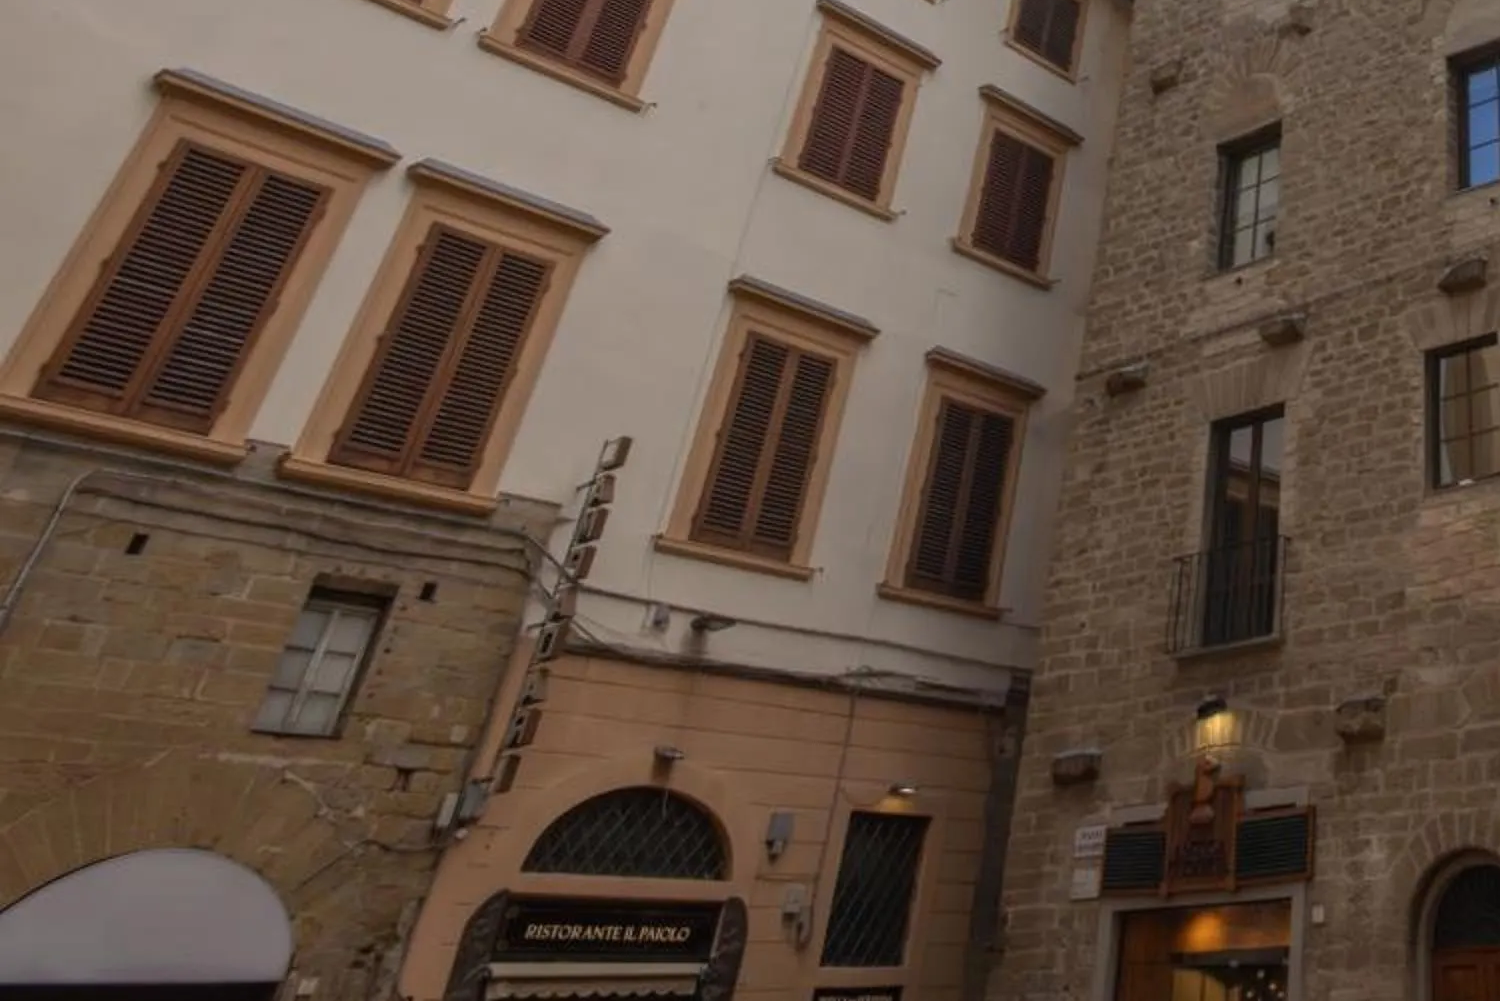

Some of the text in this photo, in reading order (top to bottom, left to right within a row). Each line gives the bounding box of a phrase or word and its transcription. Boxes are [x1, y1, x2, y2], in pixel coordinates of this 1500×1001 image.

[524, 922, 692, 943] RISTORANTE IL PAIOLO
